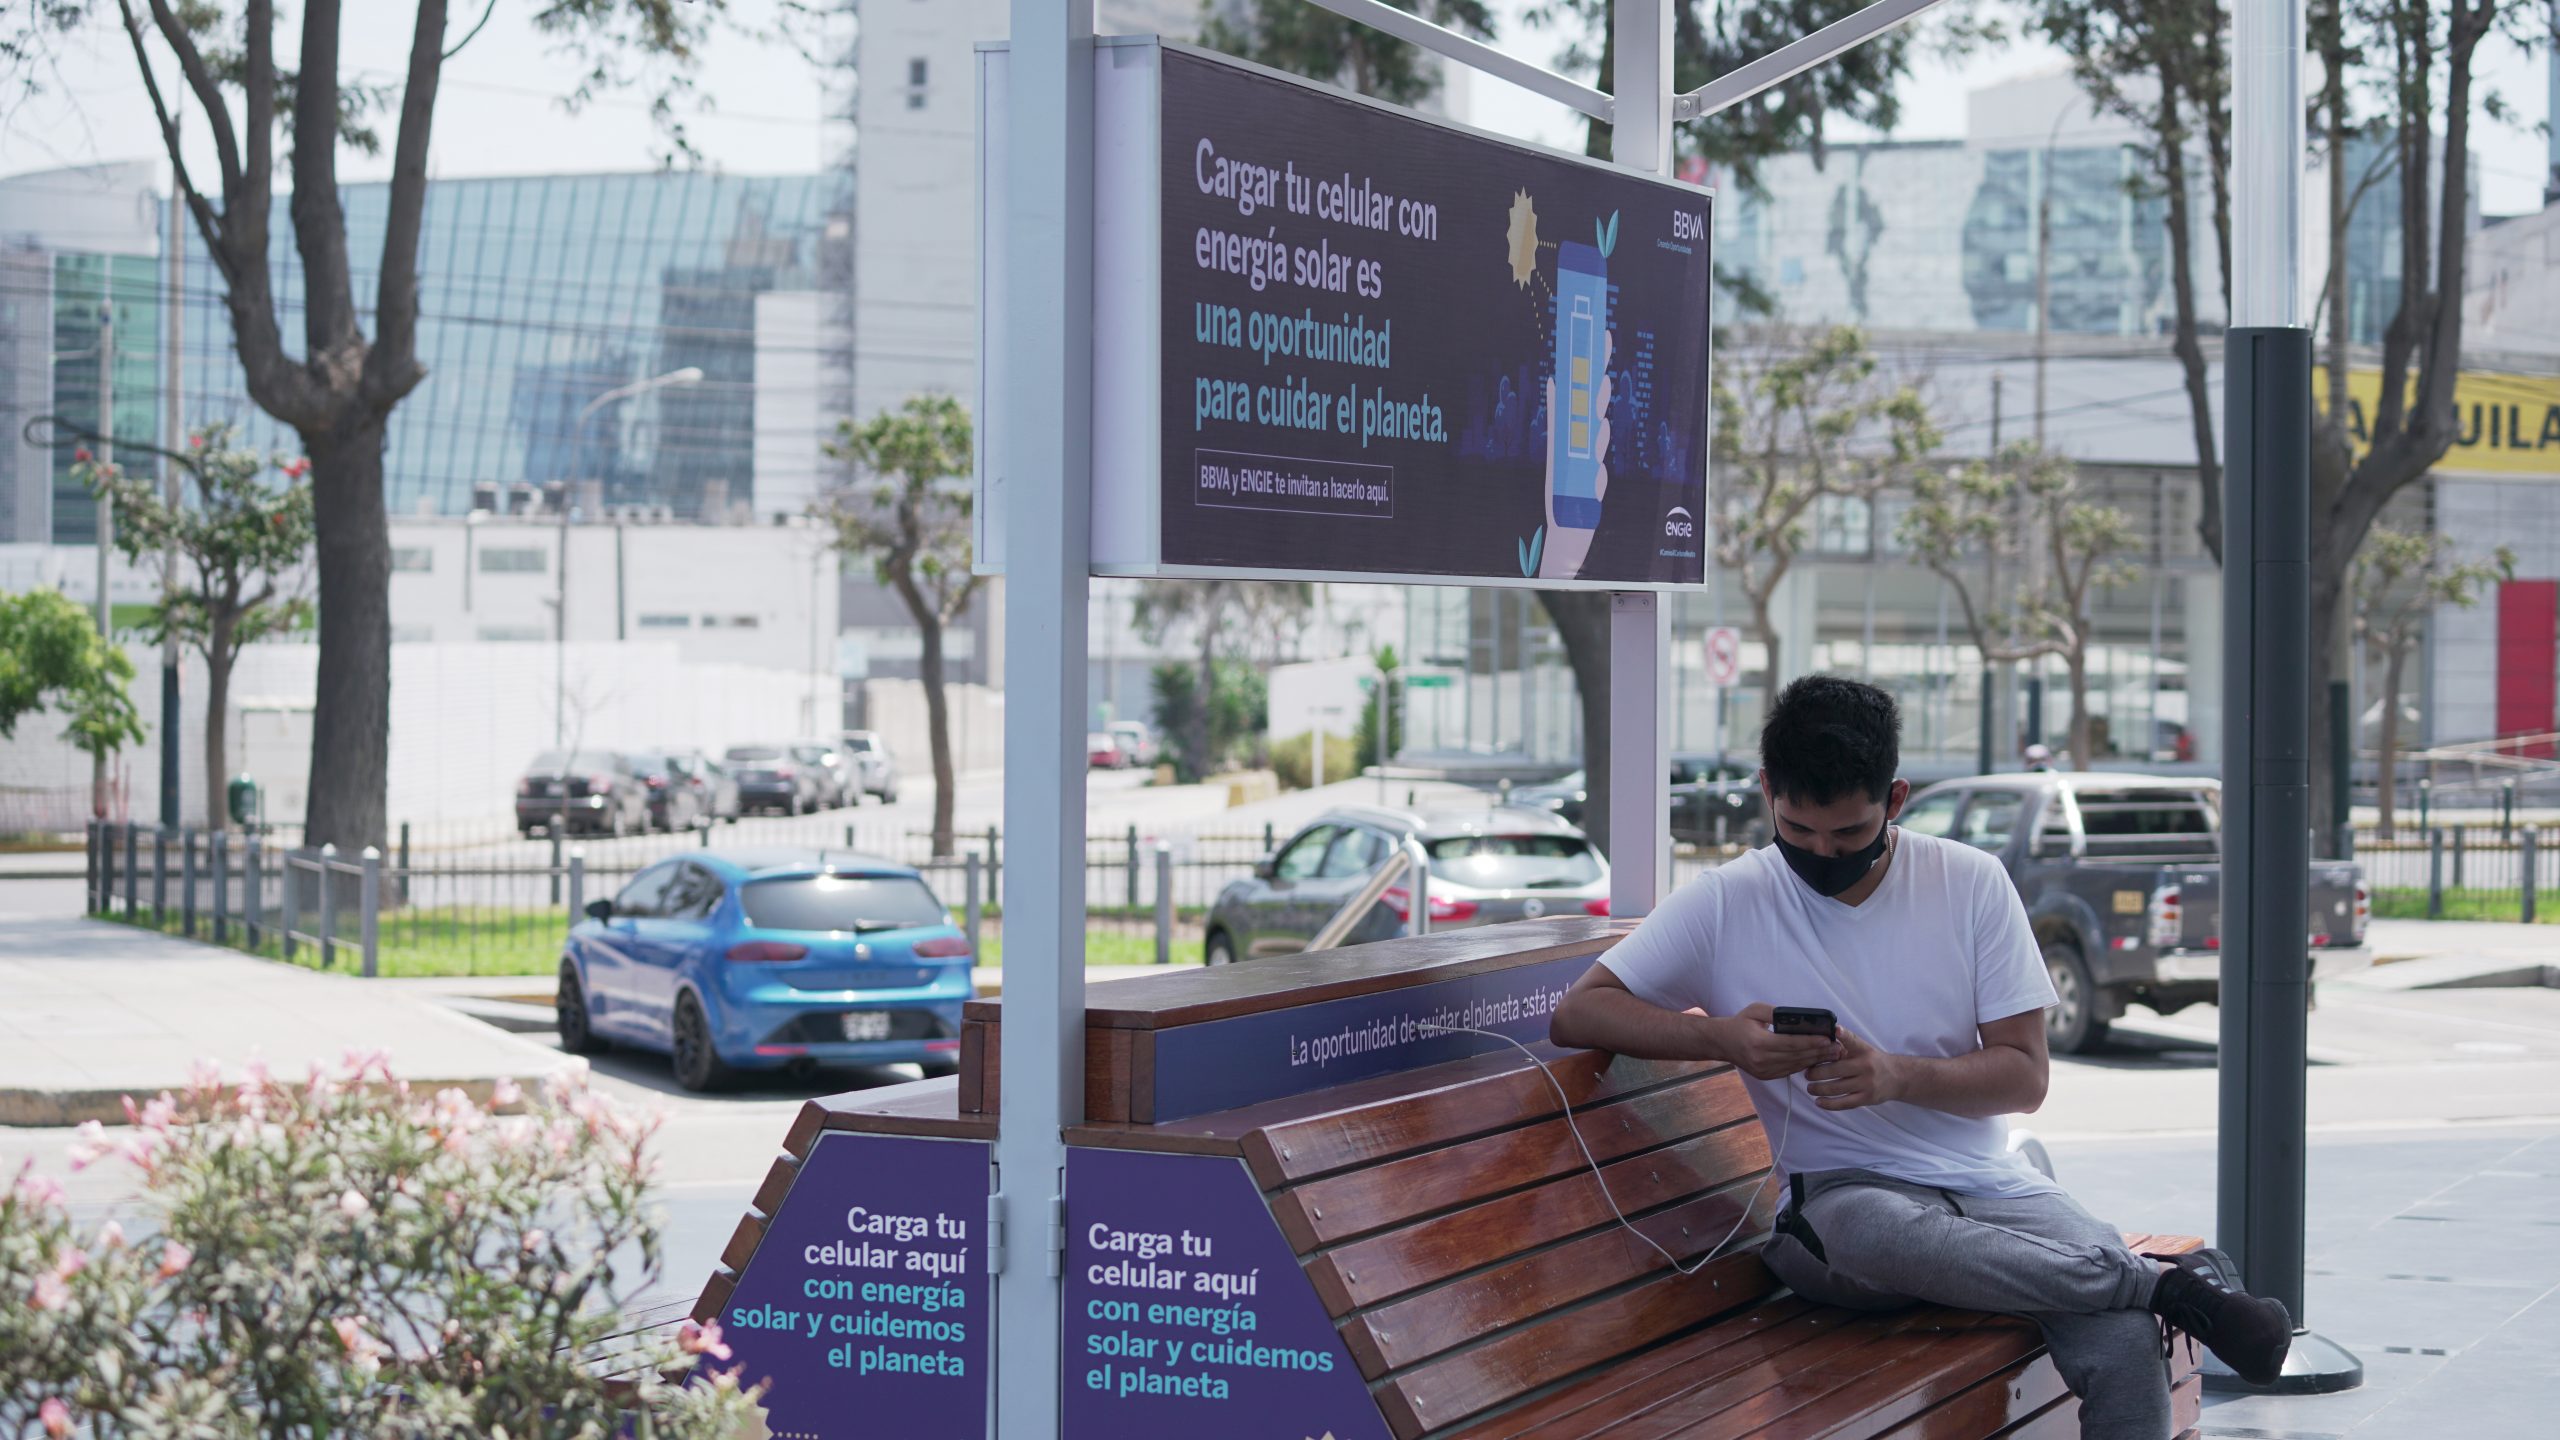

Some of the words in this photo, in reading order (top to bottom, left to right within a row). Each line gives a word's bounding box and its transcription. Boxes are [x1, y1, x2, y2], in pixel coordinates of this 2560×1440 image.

[1196, 138, 1280, 216] Cargar
[1285, 161, 1310, 215] tu
[1317, 173, 1393, 231] celular
[1399, 199, 1437, 241] con
[1674, 210, 1704, 240] BBVA
[1196, 226, 1288, 291] energía
[1294, 238, 1352, 293] solar
[1357, 259, 1382, 299] es
[1196, 302, 1242, 348] una
[1249, 307, 1390, 368] oportunidad
[1196, 377, 1250, 431] para
[1257, 374, 1331, 431] cuidar
[1337, 383, 1356, 433] el
[1362, 386, 1448, 449] planeta.
[1201, 465, 1230, 490] BBVA
[1232, 472, 1239, 496] y
[1241, 468, 1273, 493] ENGIE
[1275, 472, 1286, 494] te
[1288, 473, 1321, 497] invitan
[1323, 481, 1329, 498] a
[1331, 477, 1365, 500] hacerlo
[1367, 480, 1389, 506] aquí.
[1291, 1034, 1308, 1066] La
[1312, 1016, 1396, 1069] oportunidad
[1400, 1013, 1416, 1044] de
[1420, 1005, 1460, 1040] cuidar
[1463, 1000, 1474, 1029] el
[1475, 994, 1519, 1036] planeta
[1522, 985, 1547, 1018] está
[847, 1207, 928, 1242] Carga
[936, 1213, 966, 1239] tu
[1088, 1223, 1173, 1260] Carga
[1181, 1230, 1212, 1258] tu
[804, 1240, 898, 1269] celular
[905, 1247, 968, 1278] aquí
[803, 1278, 853, 1300] con
[861, 1281, 966, 1312] energía
[1087, 1260, 1187, 1290] celular
[1193, 1268, 1260, 1300] aquí
[732, 1304, 800, 1331] solar
[807, 1312, 823, 1338] y
[830, 1311, 966, 1343] cuidemos
[1087, 1300, 1140, 1323] con
[1148, 1303, 1257, 1336] energía
[827, 1342, 852, 1369] el
[860, 1345, 966, 1377] planeta
[1087, 1330, 1159, 1359] solar
[1166, 1340, 1183, 1367] y
[1190, 1338, 1335, 1373] cuidemos
[1086, 1364, 1112, 1391] el
[1120, 1367, 1229, 1400] planeta
